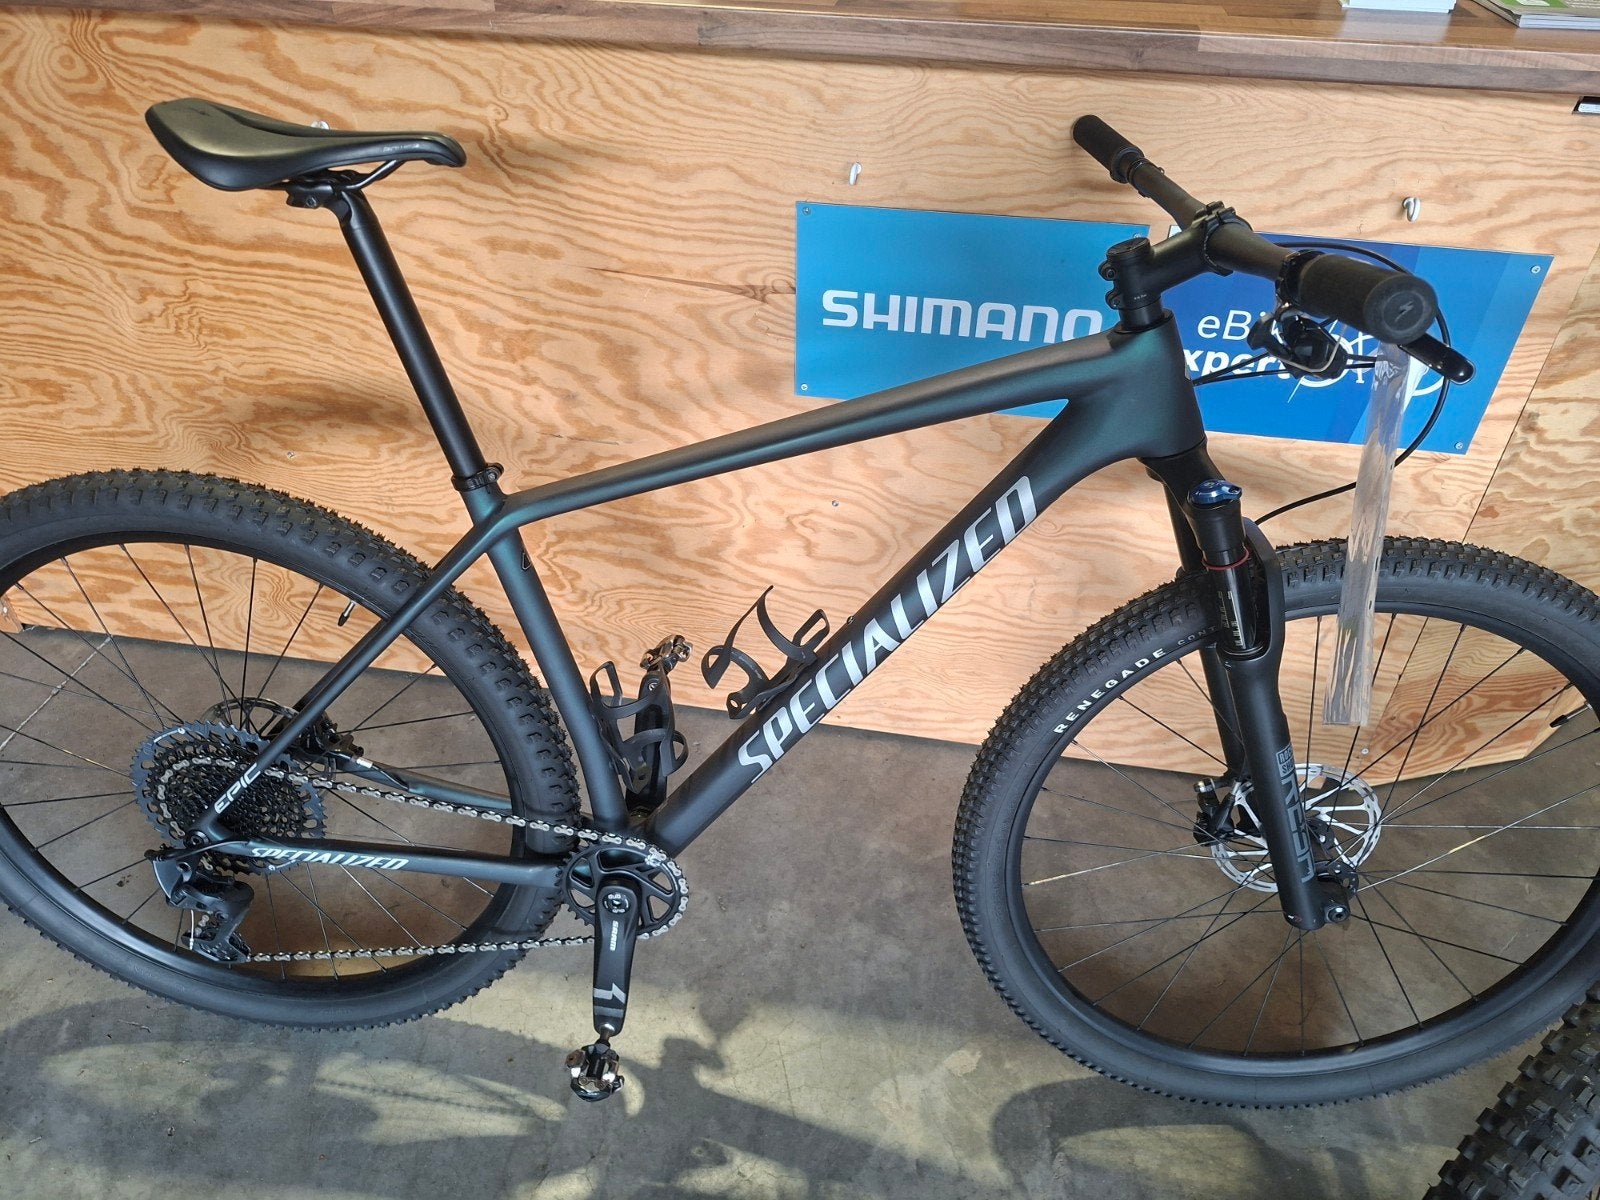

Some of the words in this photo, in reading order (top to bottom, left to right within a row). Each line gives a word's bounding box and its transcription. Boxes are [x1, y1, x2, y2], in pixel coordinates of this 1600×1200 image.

[822, 290, 1103, 344] SHIMANO
[738, 475, 1038, 784] SPECIALIZED
[1176, 625, 1218, 646] CONT
[1053, 648, 1166, 734] RENEGADE
[214, 762, 261, 814] EPIC
[251, 847, 409, 870] SPECIALIZED
[609, 920, 619, 952] SRAM
